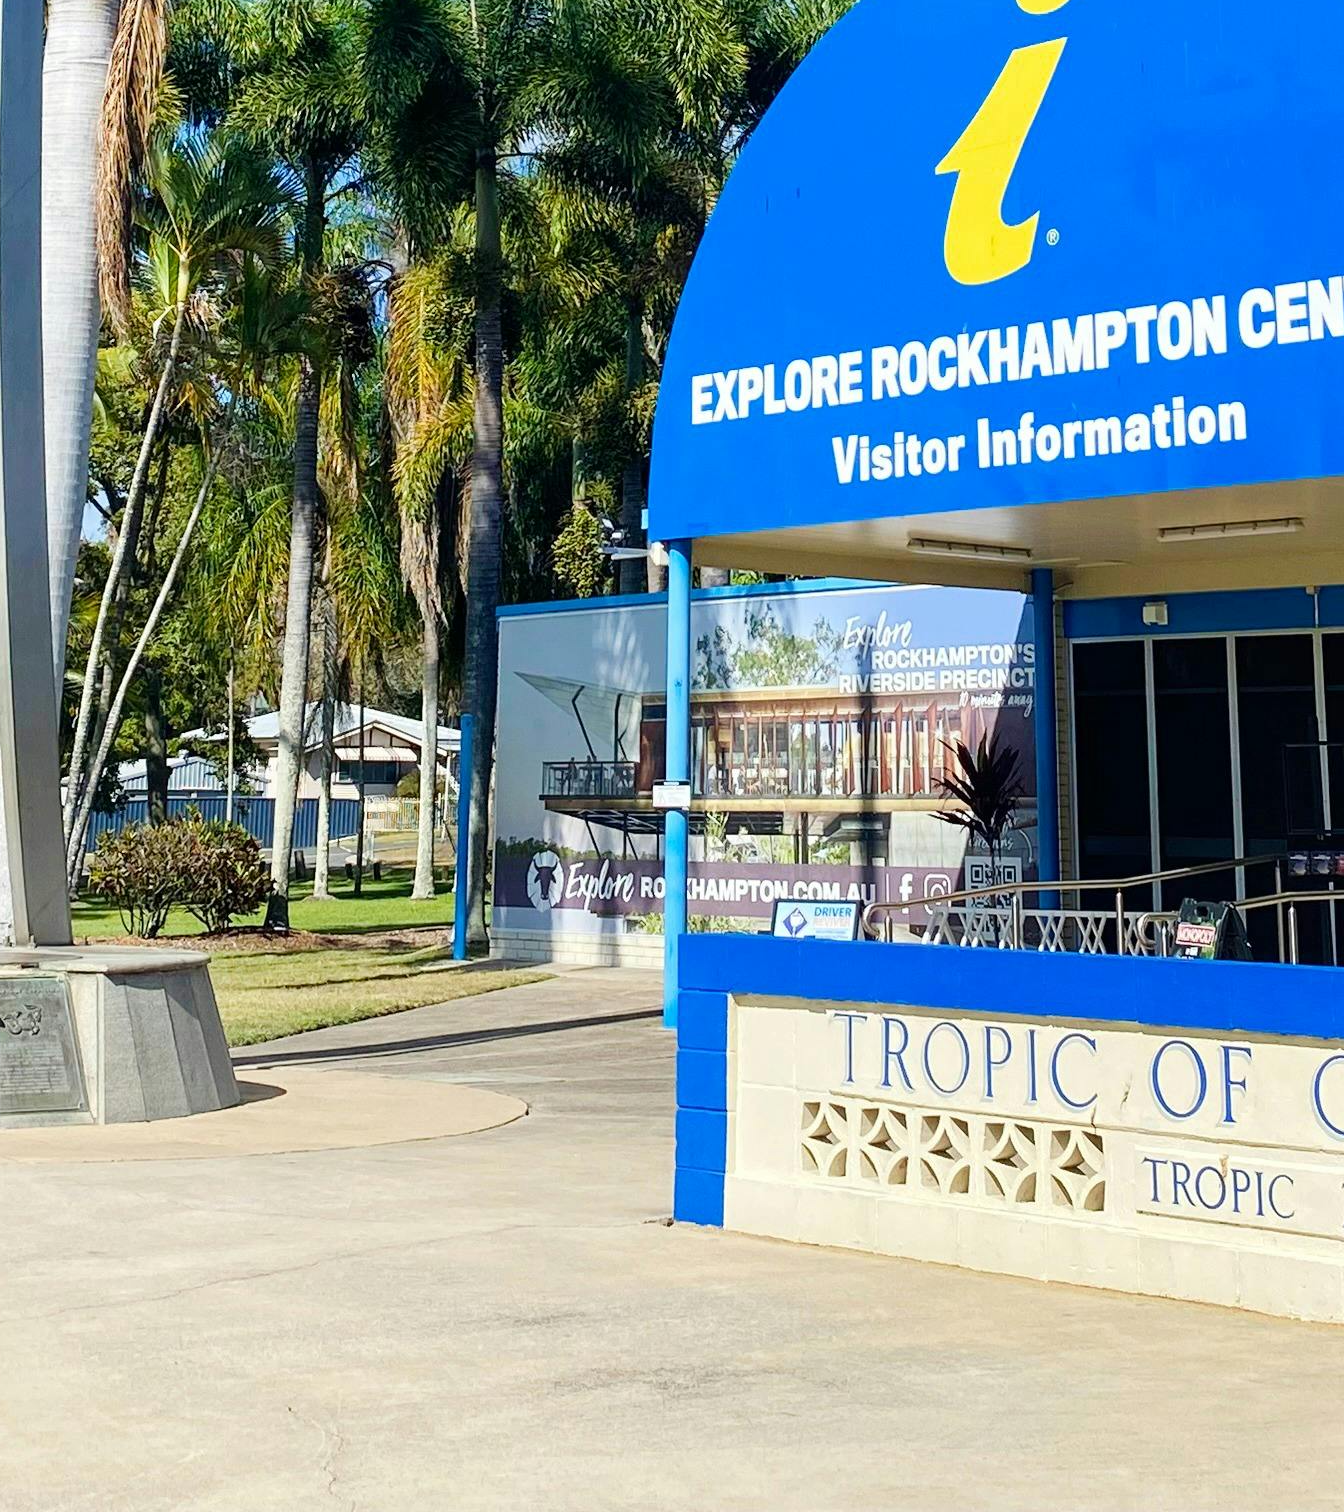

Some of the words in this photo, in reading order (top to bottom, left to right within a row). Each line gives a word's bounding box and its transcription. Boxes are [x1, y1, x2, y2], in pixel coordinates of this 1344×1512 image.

[691, 349, 863, 425] EXPLORE
[873, 296, 1227, 399] ROCKHAMPTON
[831, 433, 968, 484] Visitor
[978, 396, 1247, 469] Information
[843, 610, 913, 660] Explore
[872, 644, 1035, 670] ROCKHAMPTON'S
[839, 671, 938, 694] RIVERSIDE
[940, 668, 1035, 690] PRECINCT
[1008, 695, 1033, 717] away
[564, 861, 635, 912] Explore
[815, 907, 852, 916] DRIVER
[833, 1012, 1099, 1112] TROPIC
[1150, 1040, 1253, 1127] OF
[1142, 1157, 1296, 1219] TROPIC
